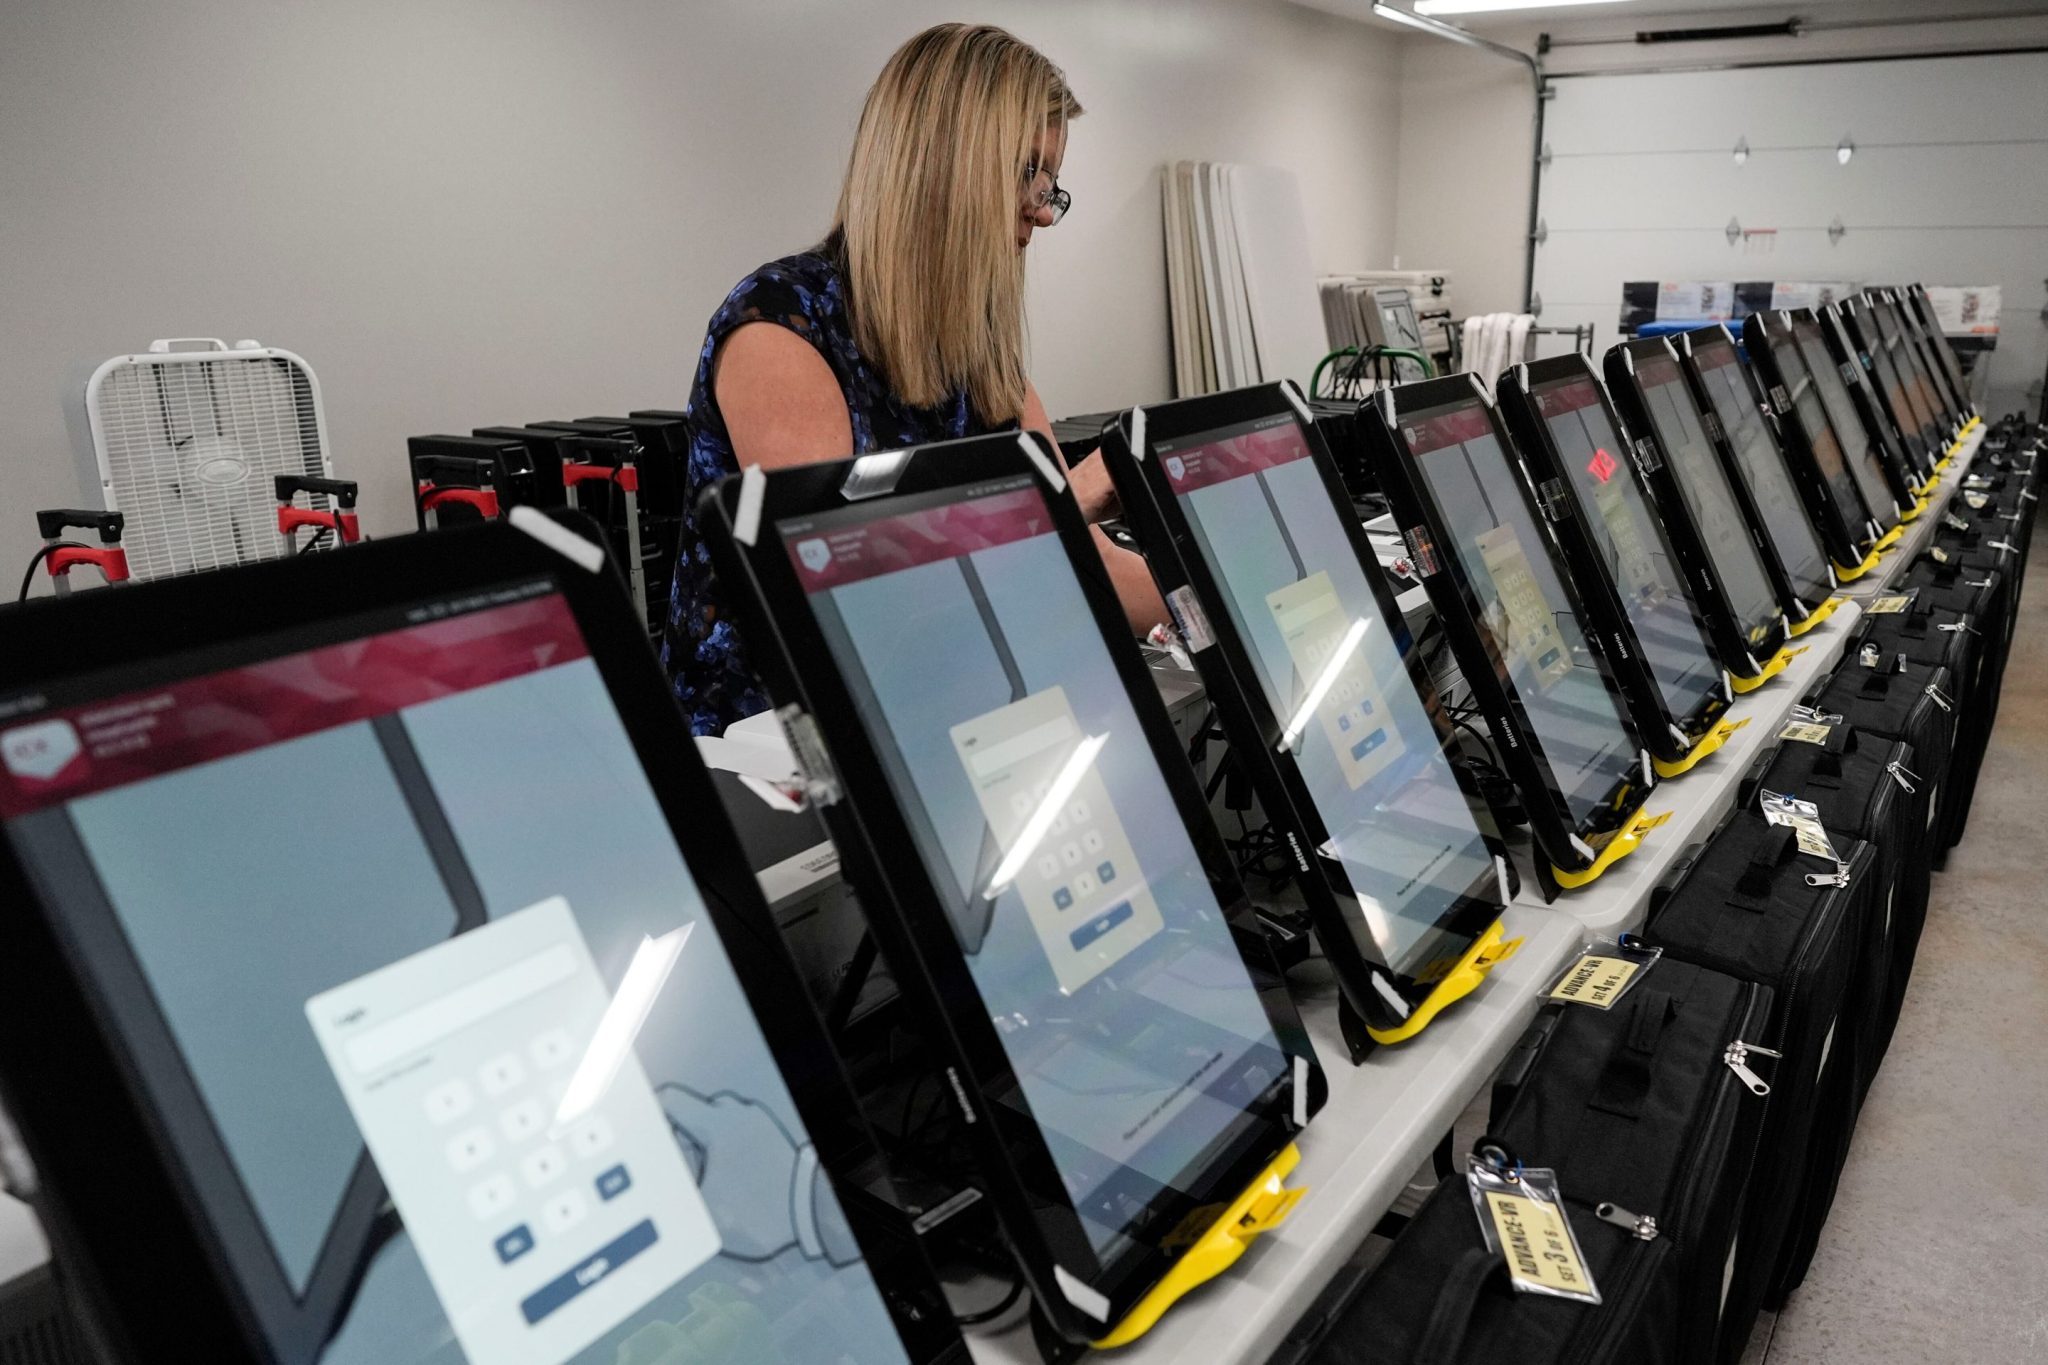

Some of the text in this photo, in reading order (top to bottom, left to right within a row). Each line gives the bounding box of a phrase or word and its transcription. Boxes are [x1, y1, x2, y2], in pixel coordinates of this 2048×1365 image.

[1614, 632, 1628, 659] Batteries
[1501, 716, 1518, 748] Batteries
[1287, 831, 1310, 872] Batteries
[1561, 960, 1603, 996] ADVANCE-VR
[1603, 979, 1616, 987] OF
[1592, 990, 1607, 1001] SET
[1593, 984, 1612, 992] 4
[1498, 1200, 1541, 1278] ADVANCE-VR
[1543, 1229, 1559, 1238] 6
[1546, 1238, 1564, 1252] OF
[1543, 1251, 1569, 1264] 3
[1557, 1265, 1577, 1283] SET
